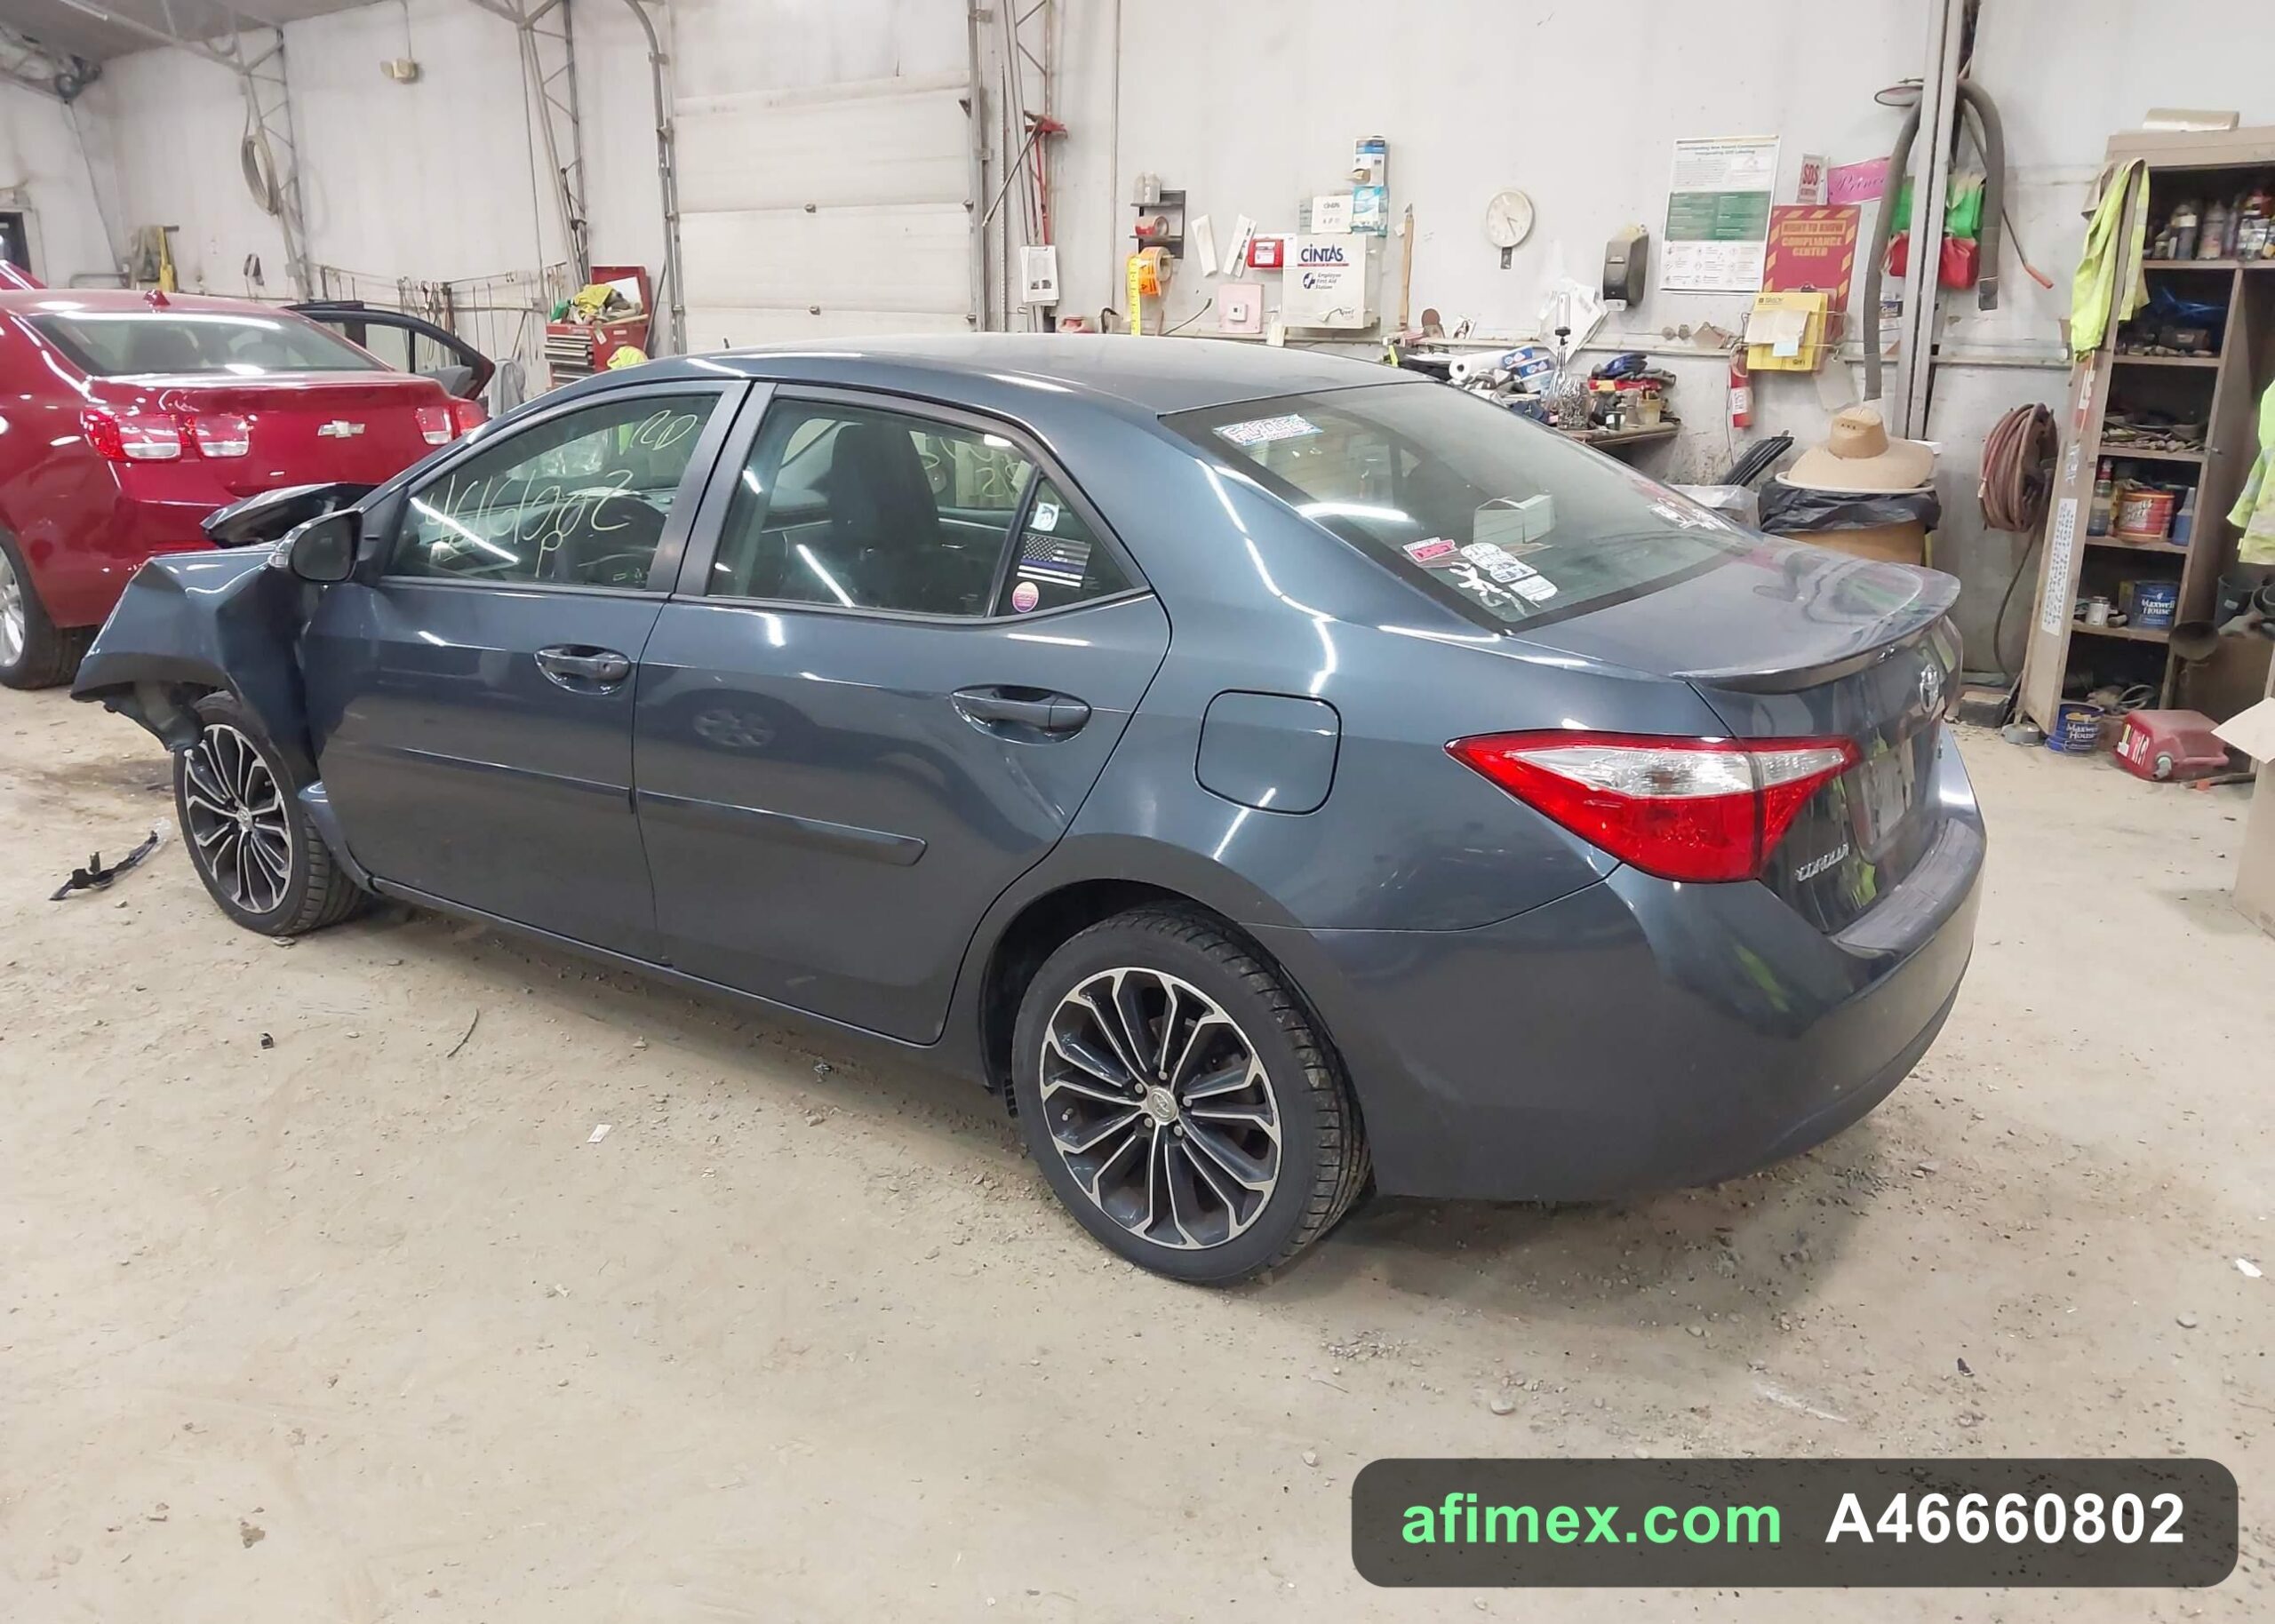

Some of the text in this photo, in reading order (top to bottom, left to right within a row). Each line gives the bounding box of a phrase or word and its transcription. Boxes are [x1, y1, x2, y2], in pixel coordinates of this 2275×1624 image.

[1802, 163, 1819, 186] SDS
[1782, 236, 1842, 247] COMPLIANCE
[1792, 247, 1829, 257] CENTER
[2141, 599, 2176, 609] Maxwell
